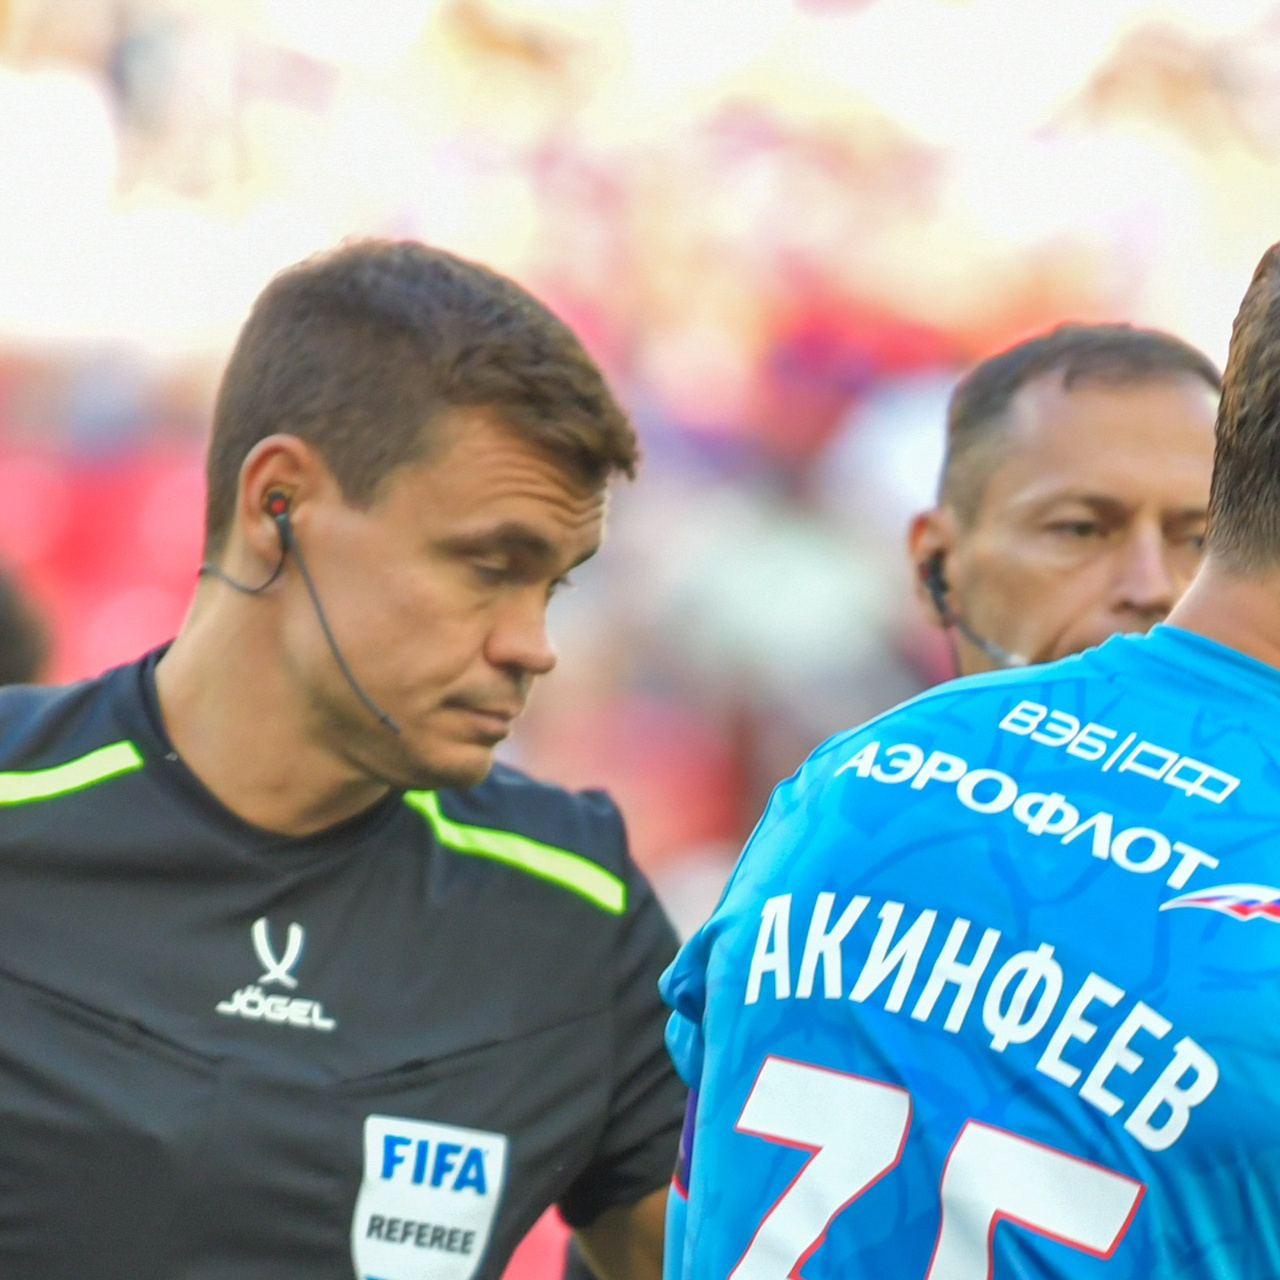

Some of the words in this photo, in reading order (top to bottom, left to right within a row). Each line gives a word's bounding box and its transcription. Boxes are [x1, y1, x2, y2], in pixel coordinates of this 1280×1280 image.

[834, 741, 1219, 890] АЭРОФЛОТ
[215, 985, 336, 1031] JÖGEL
[744, 891, 1219, 1151] АКИНФЕЕВ
[381, 1134, 489, 1196] FIFA
[366, 1214, 477, 1255] REFEREE
